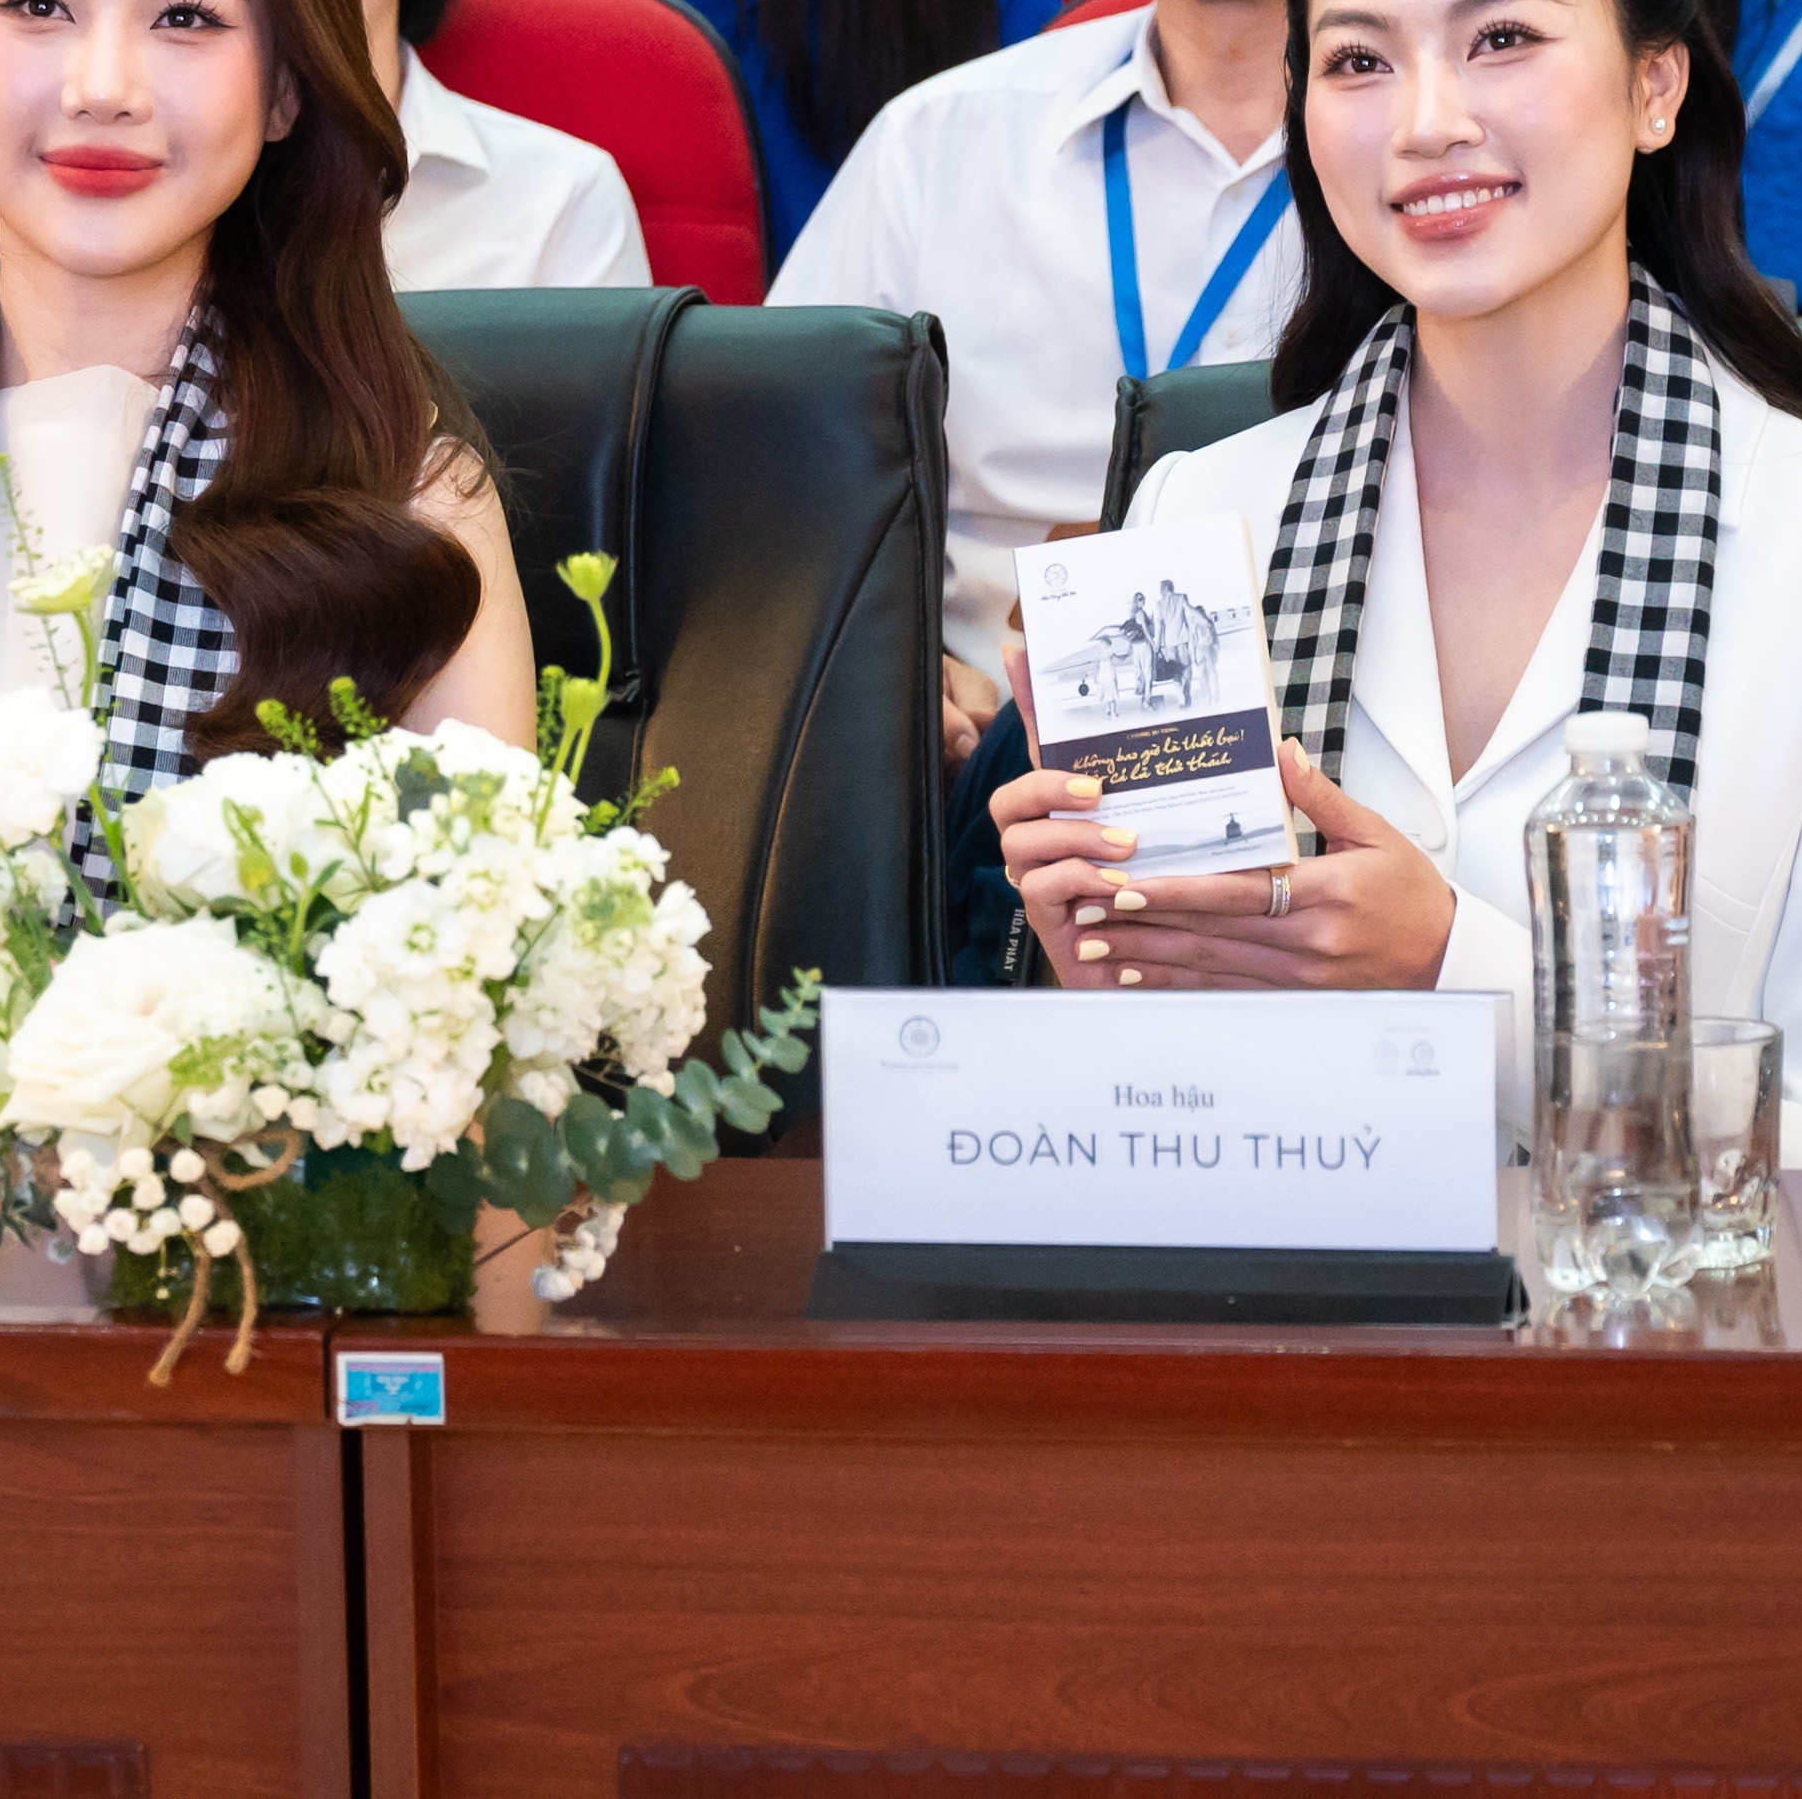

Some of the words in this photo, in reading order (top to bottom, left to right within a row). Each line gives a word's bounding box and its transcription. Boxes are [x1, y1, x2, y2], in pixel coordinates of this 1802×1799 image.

[1073, 754, 1115, 775] Không
[1116, 747, 1138, 762] bao
[1163, 736, 1181, 754] là
[1113, 1084, 1162, 1109] Hoa
[1171, 1084, 1214, 1114] hậu
[947, 1123, 1098, 1169] ĐOÀN
[1120, 1133, 1222, 1169] THU
[1243, 1125, 1383, 1172] THUỶ
